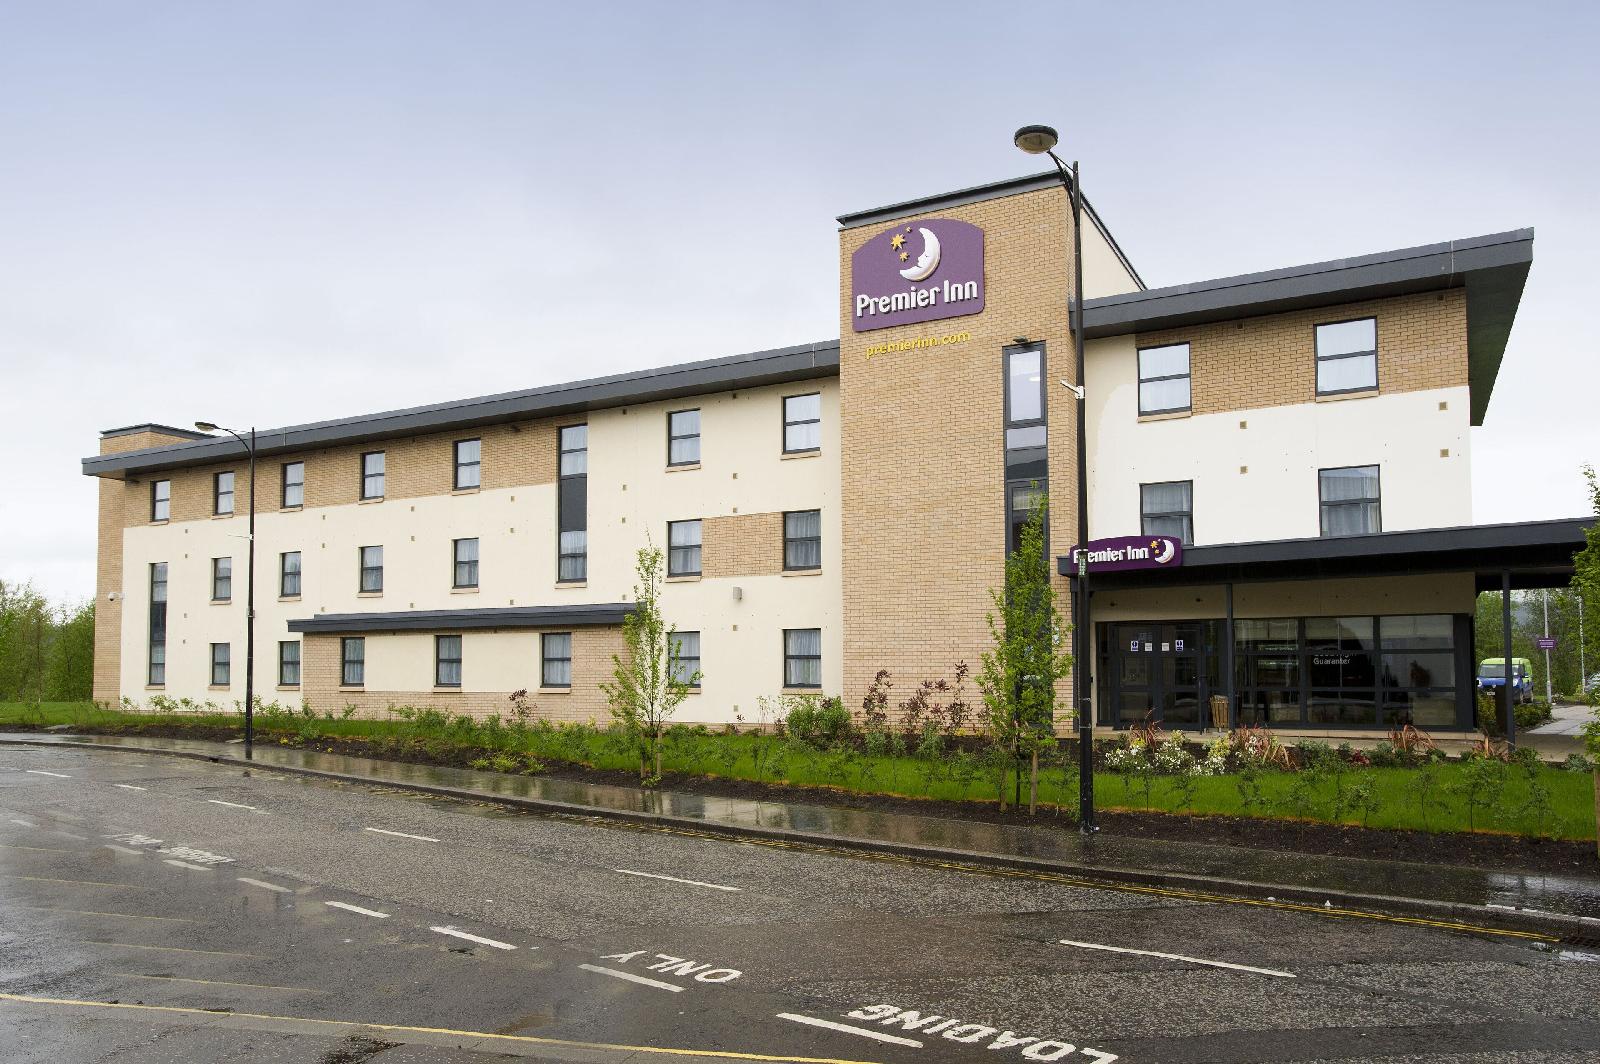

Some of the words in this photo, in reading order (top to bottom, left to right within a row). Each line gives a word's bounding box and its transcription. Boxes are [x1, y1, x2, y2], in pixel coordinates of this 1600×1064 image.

[856, 286, 941, 317] Premier
[943, 279, 978, 303] Inn
[865, 331, 971, 360] premierinn.com
[1073, 547, 1126, 564] Pemier
[1126, 545, 1149, 560] Inn
[600, 950, 743, 983] ONLY
[842, 1004, 1118, 1064] LOADING
